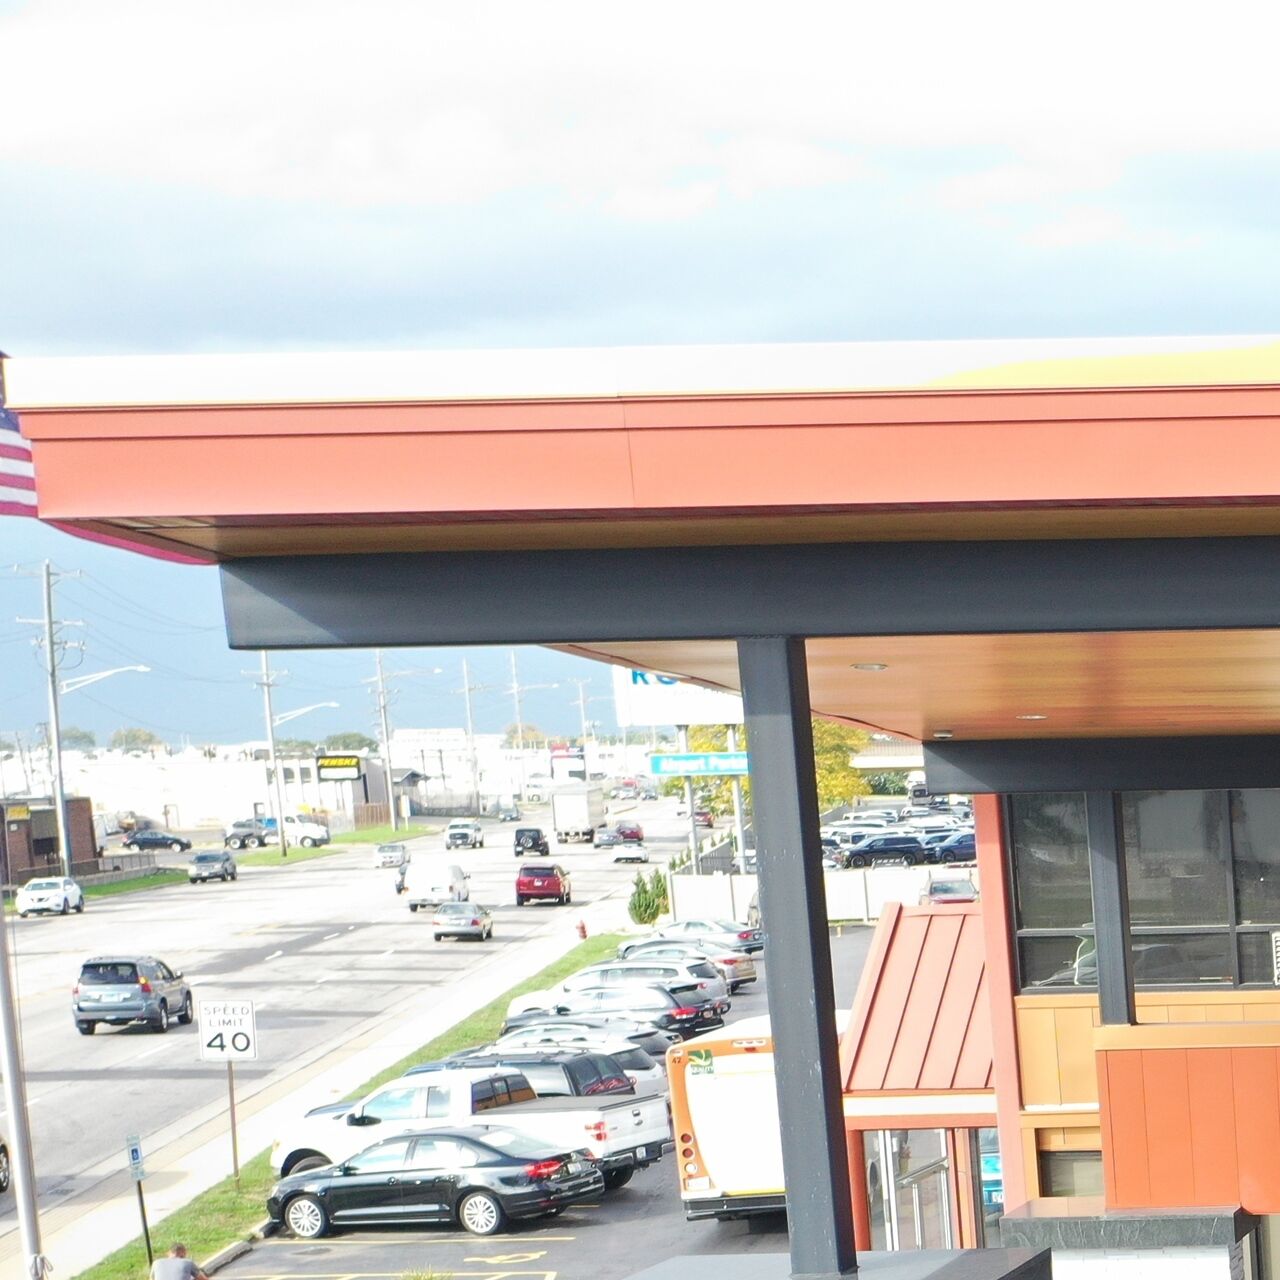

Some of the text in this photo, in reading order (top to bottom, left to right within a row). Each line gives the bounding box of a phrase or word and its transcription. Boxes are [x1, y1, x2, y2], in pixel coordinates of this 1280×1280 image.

[318, 757, 358, 766] PENSKE
[204, 1006, 249, 1015] SPEED
[209, 1018, 244, 1027] LIMIT
[206, 1032, 250, 1052] 40
